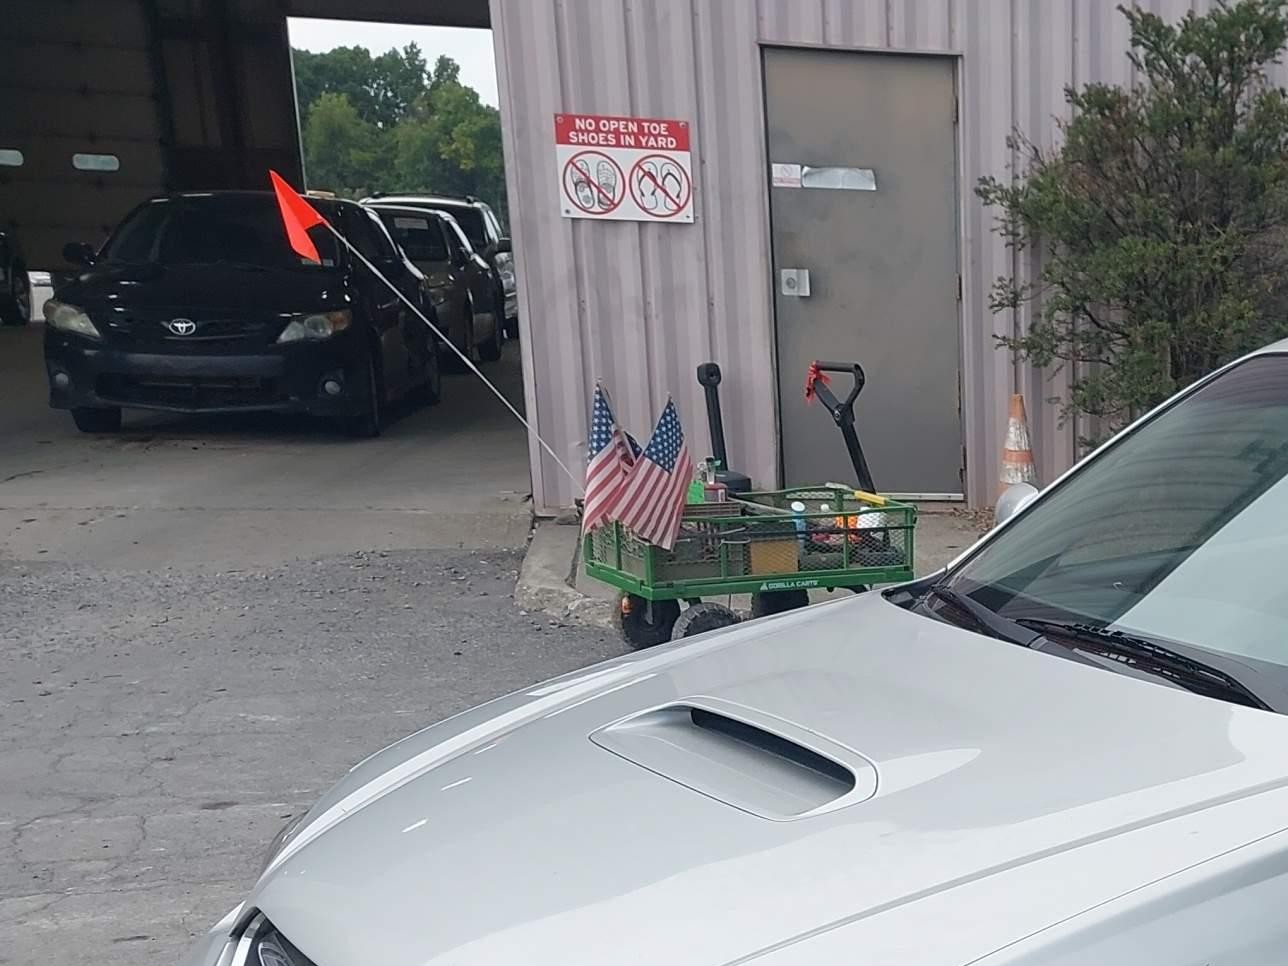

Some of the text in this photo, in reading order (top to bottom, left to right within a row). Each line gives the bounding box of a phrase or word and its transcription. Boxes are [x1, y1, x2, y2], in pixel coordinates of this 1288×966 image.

[575, 118, 669, 135] NO OPEN TOE
[569, 131, 677, 148] SHOES IN YARD
